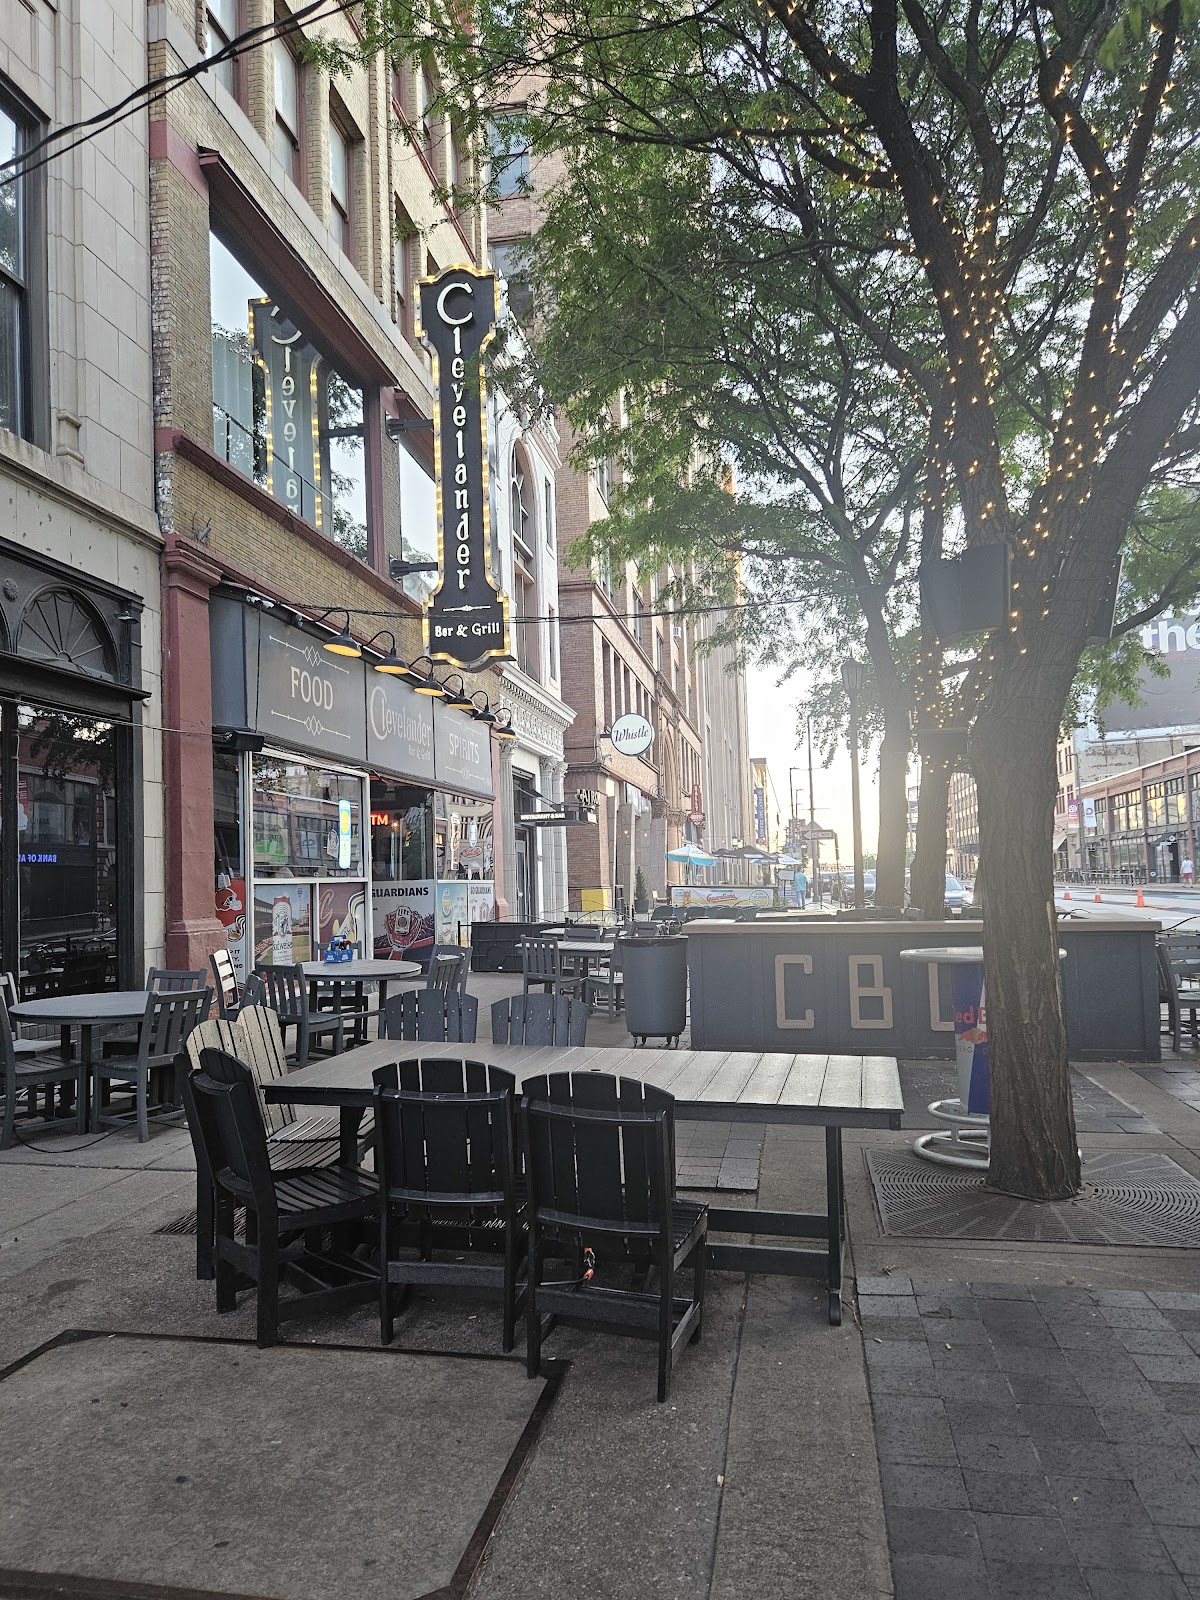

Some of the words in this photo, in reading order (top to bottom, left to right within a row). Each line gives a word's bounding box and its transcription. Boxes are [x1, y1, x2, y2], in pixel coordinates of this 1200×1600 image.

[436, 282, 474, 591] Clevelander
[434, 625, 454, 638] Bar
[456, 623, 469, 638] &
[471, 622, 500, 637] Grill
[290, 665, 334, 711] FOOD
[369, 685, 432, 748] Clevelander
[613, 725, 649, 743] Whistle
[449, 732, 480, 765] SPIRITS
[370, 814, 389, 826] TM
[397, 908, 411, 917] Lite
[953, 1005, 975, 1025] ed
